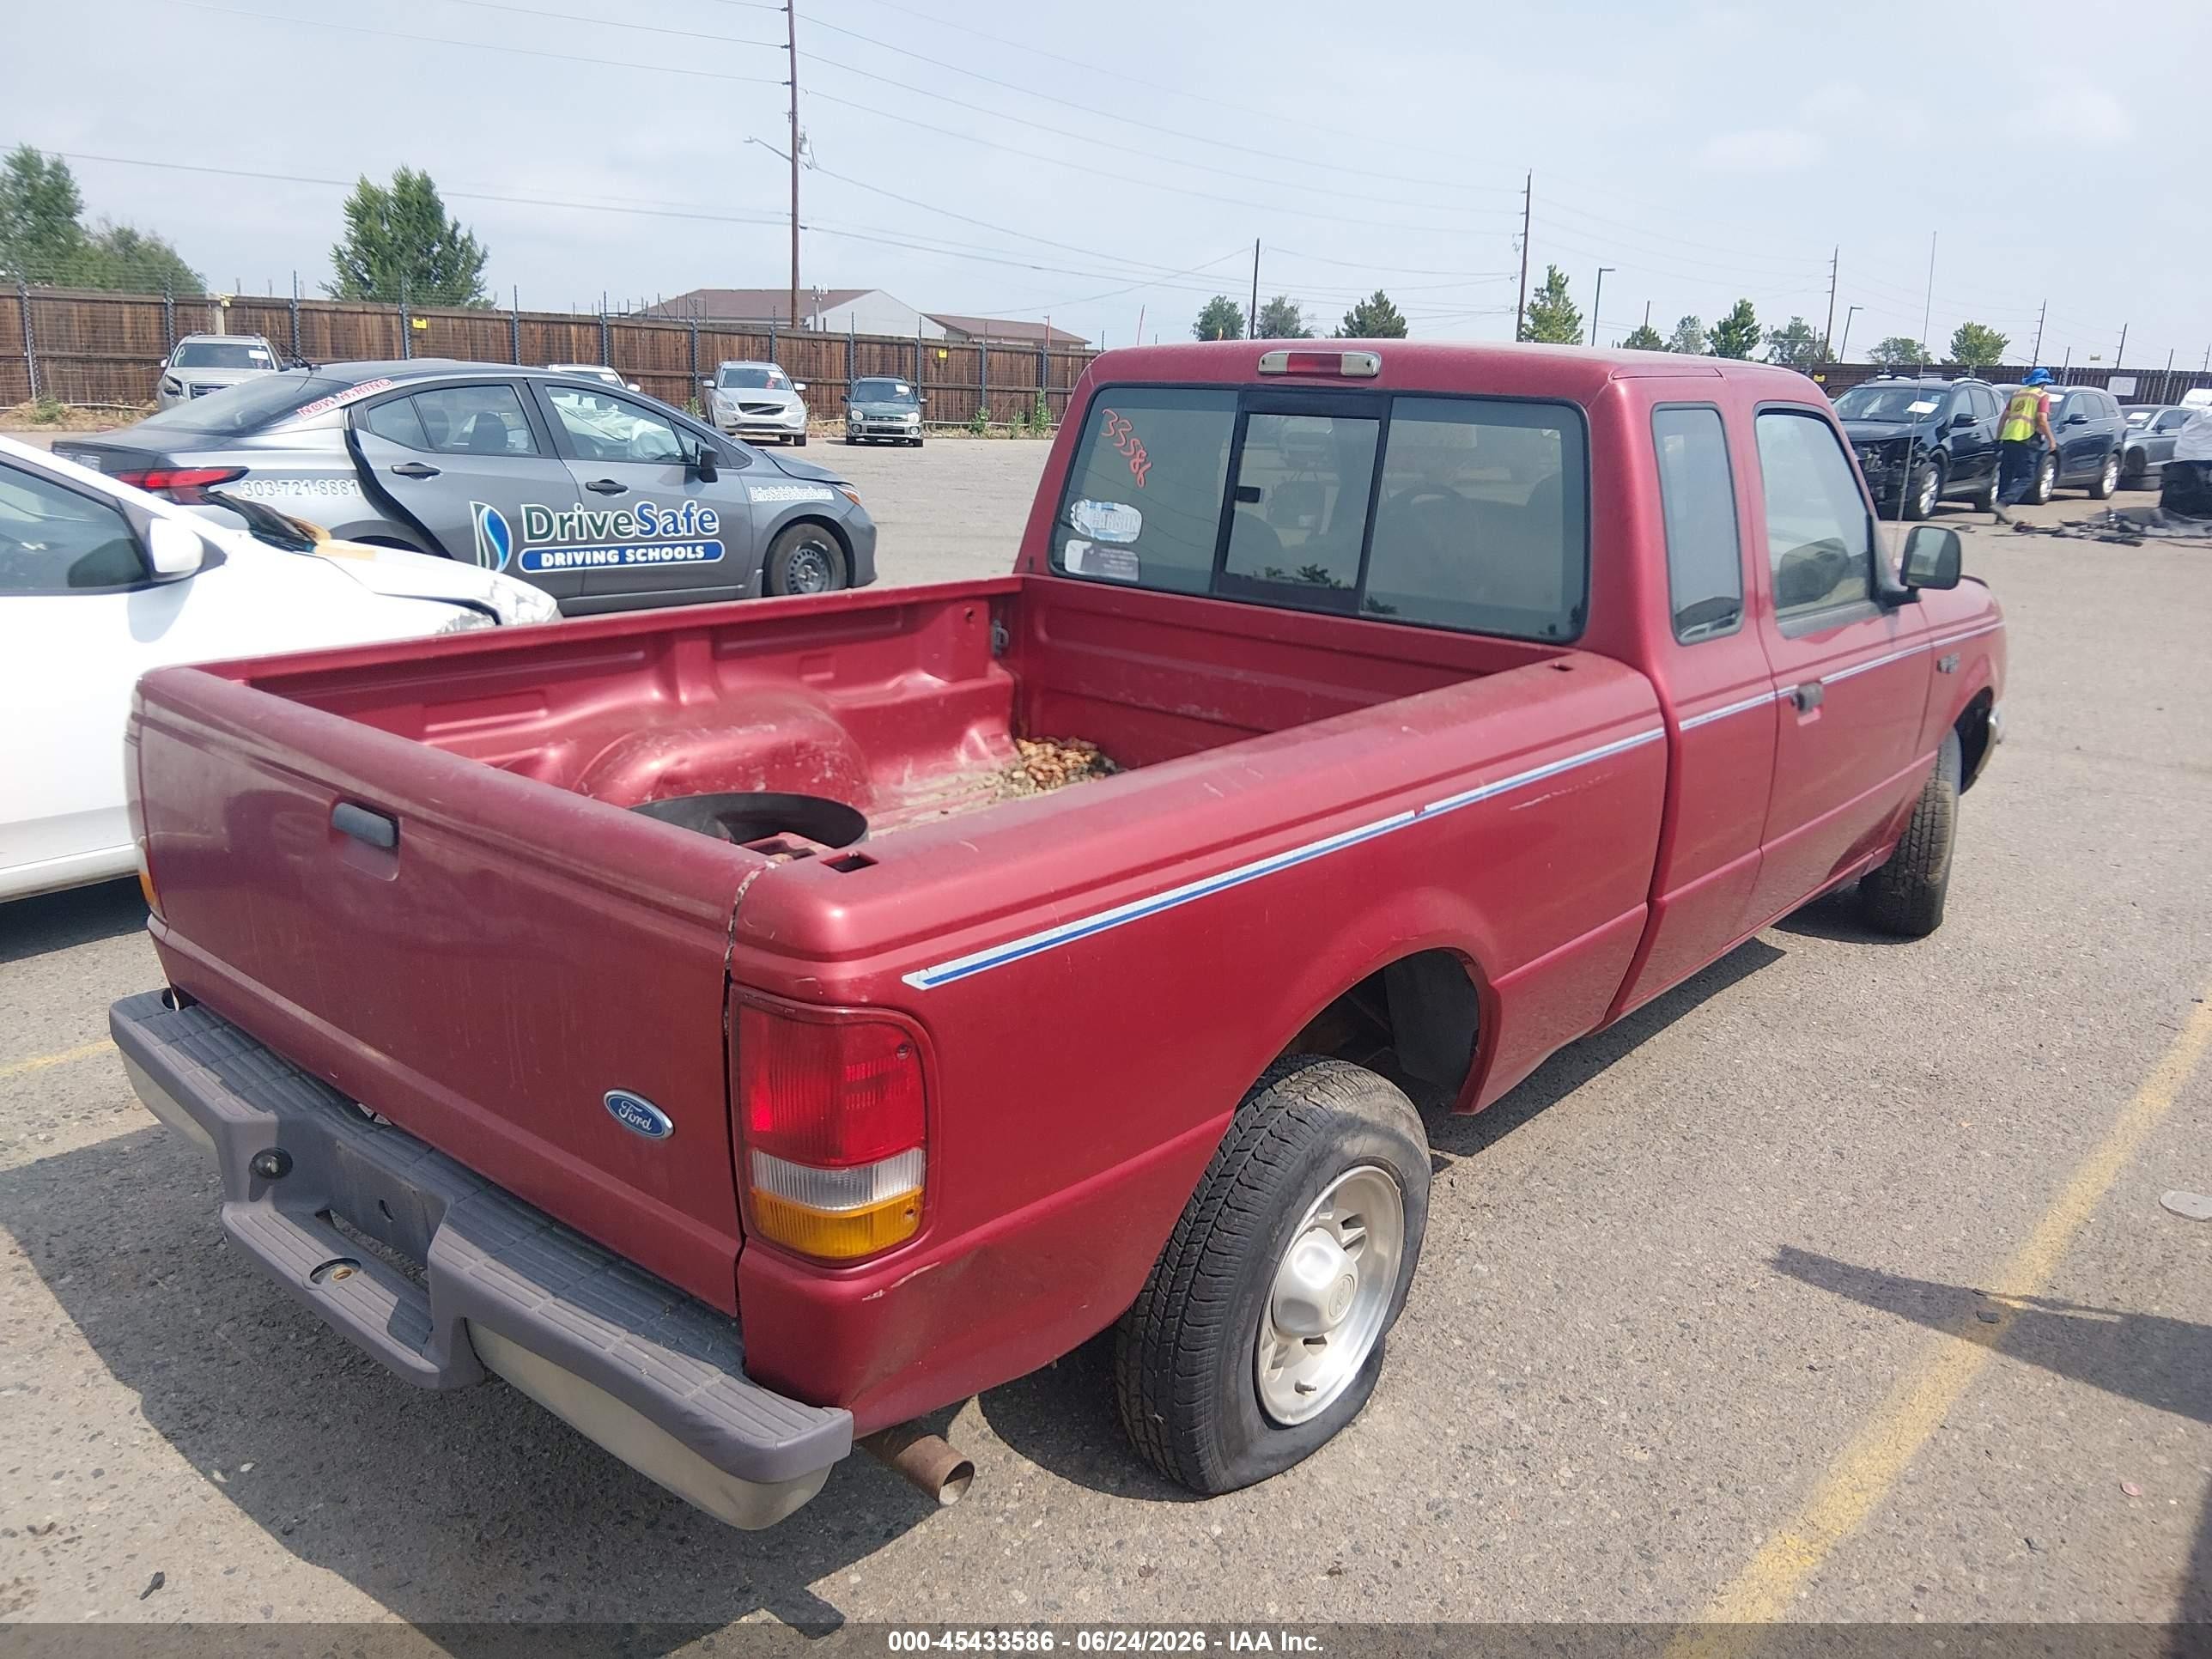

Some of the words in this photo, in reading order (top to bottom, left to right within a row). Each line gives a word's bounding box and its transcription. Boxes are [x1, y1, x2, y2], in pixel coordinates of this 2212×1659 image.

[298, 398, 336, 417] NOW
[1101, 409, 1152, 488] 33586
[240, 479, 359, 497] 303-721-8881
[520, 500, 719, 542] DriveSafe
[540, 550, 619, 567] DRIVING
[625, 545, 704, 563] SCHOOLS
[618, 1100, 653, 1130] Ford
